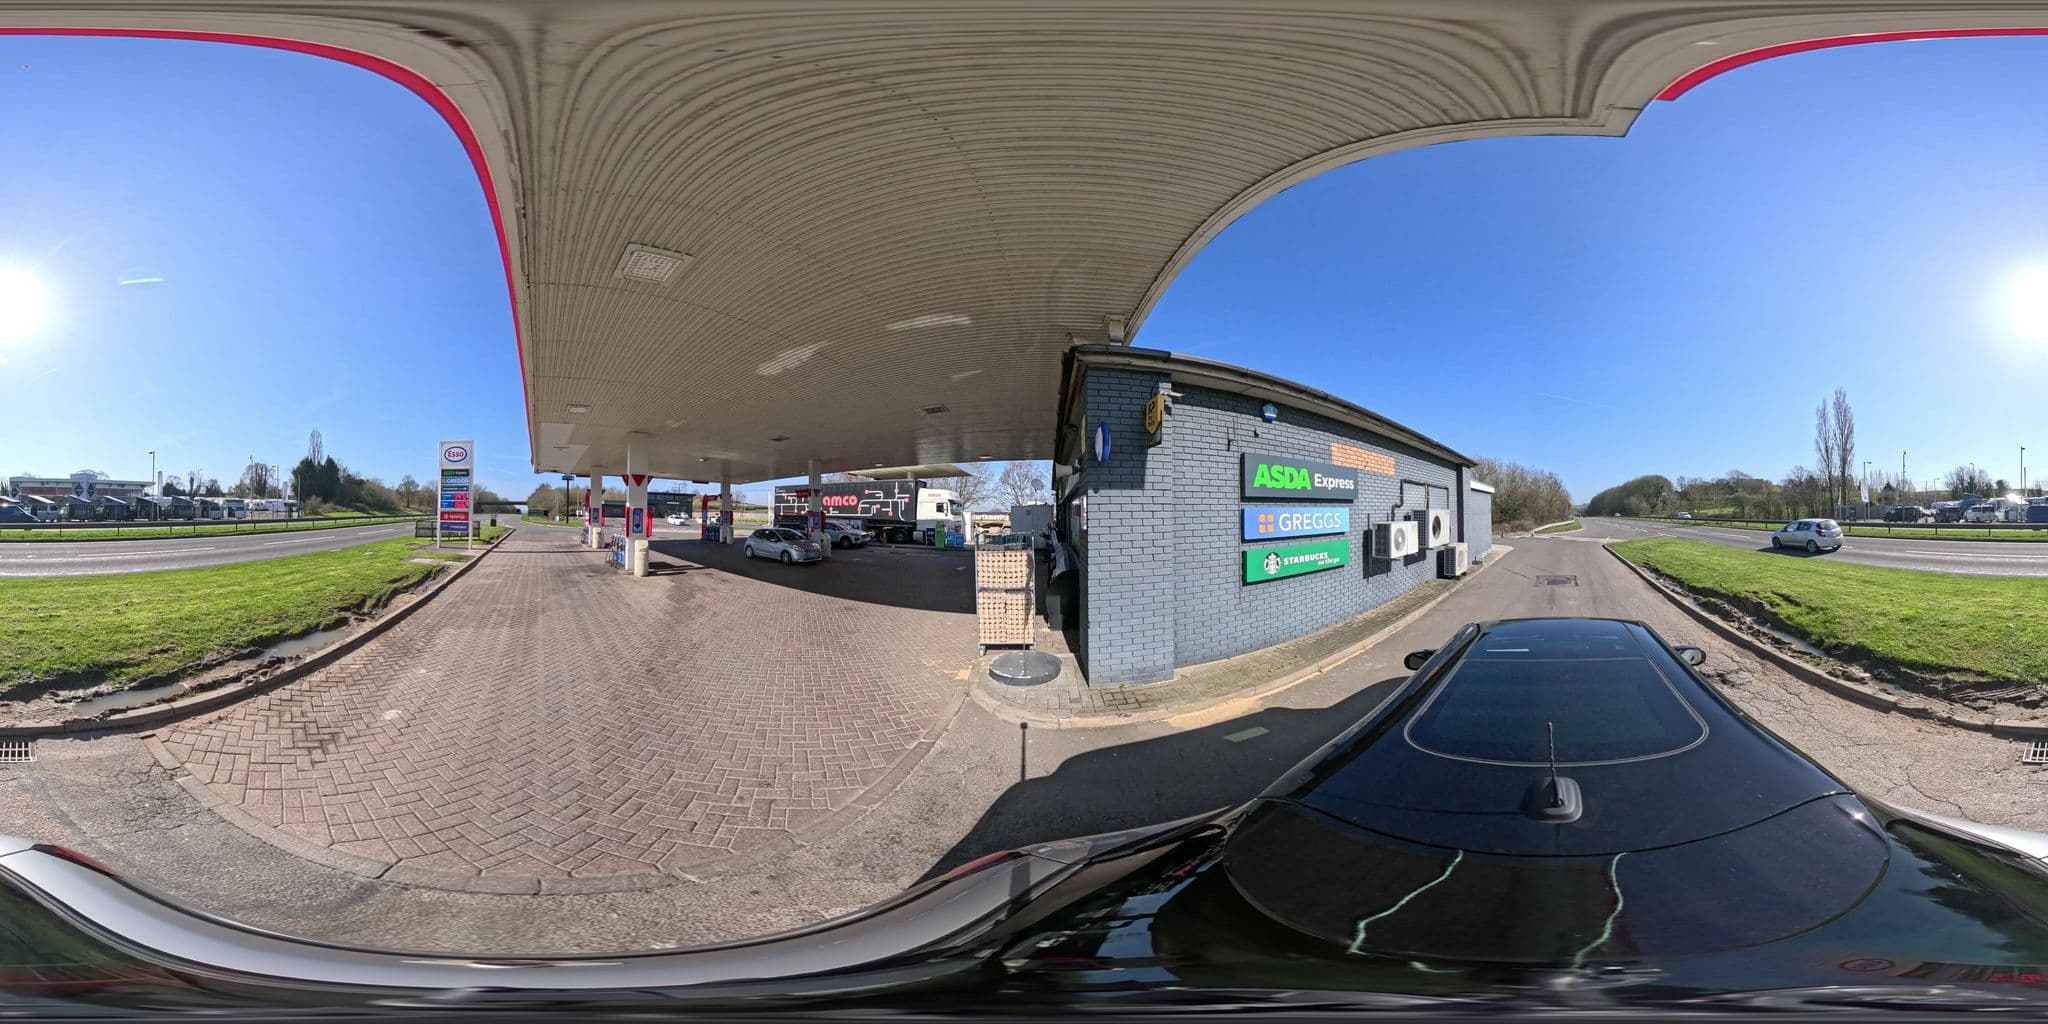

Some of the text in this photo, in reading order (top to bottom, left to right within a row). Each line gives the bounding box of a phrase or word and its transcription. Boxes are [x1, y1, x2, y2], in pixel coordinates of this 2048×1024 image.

[1253, 463, 1355, 491] ASDA Express
[823, 495, 858, 506] amco
[1279, 512, 1341, 531] GREGGS
[1283, 551, 1329, 565] STARBUCKS
